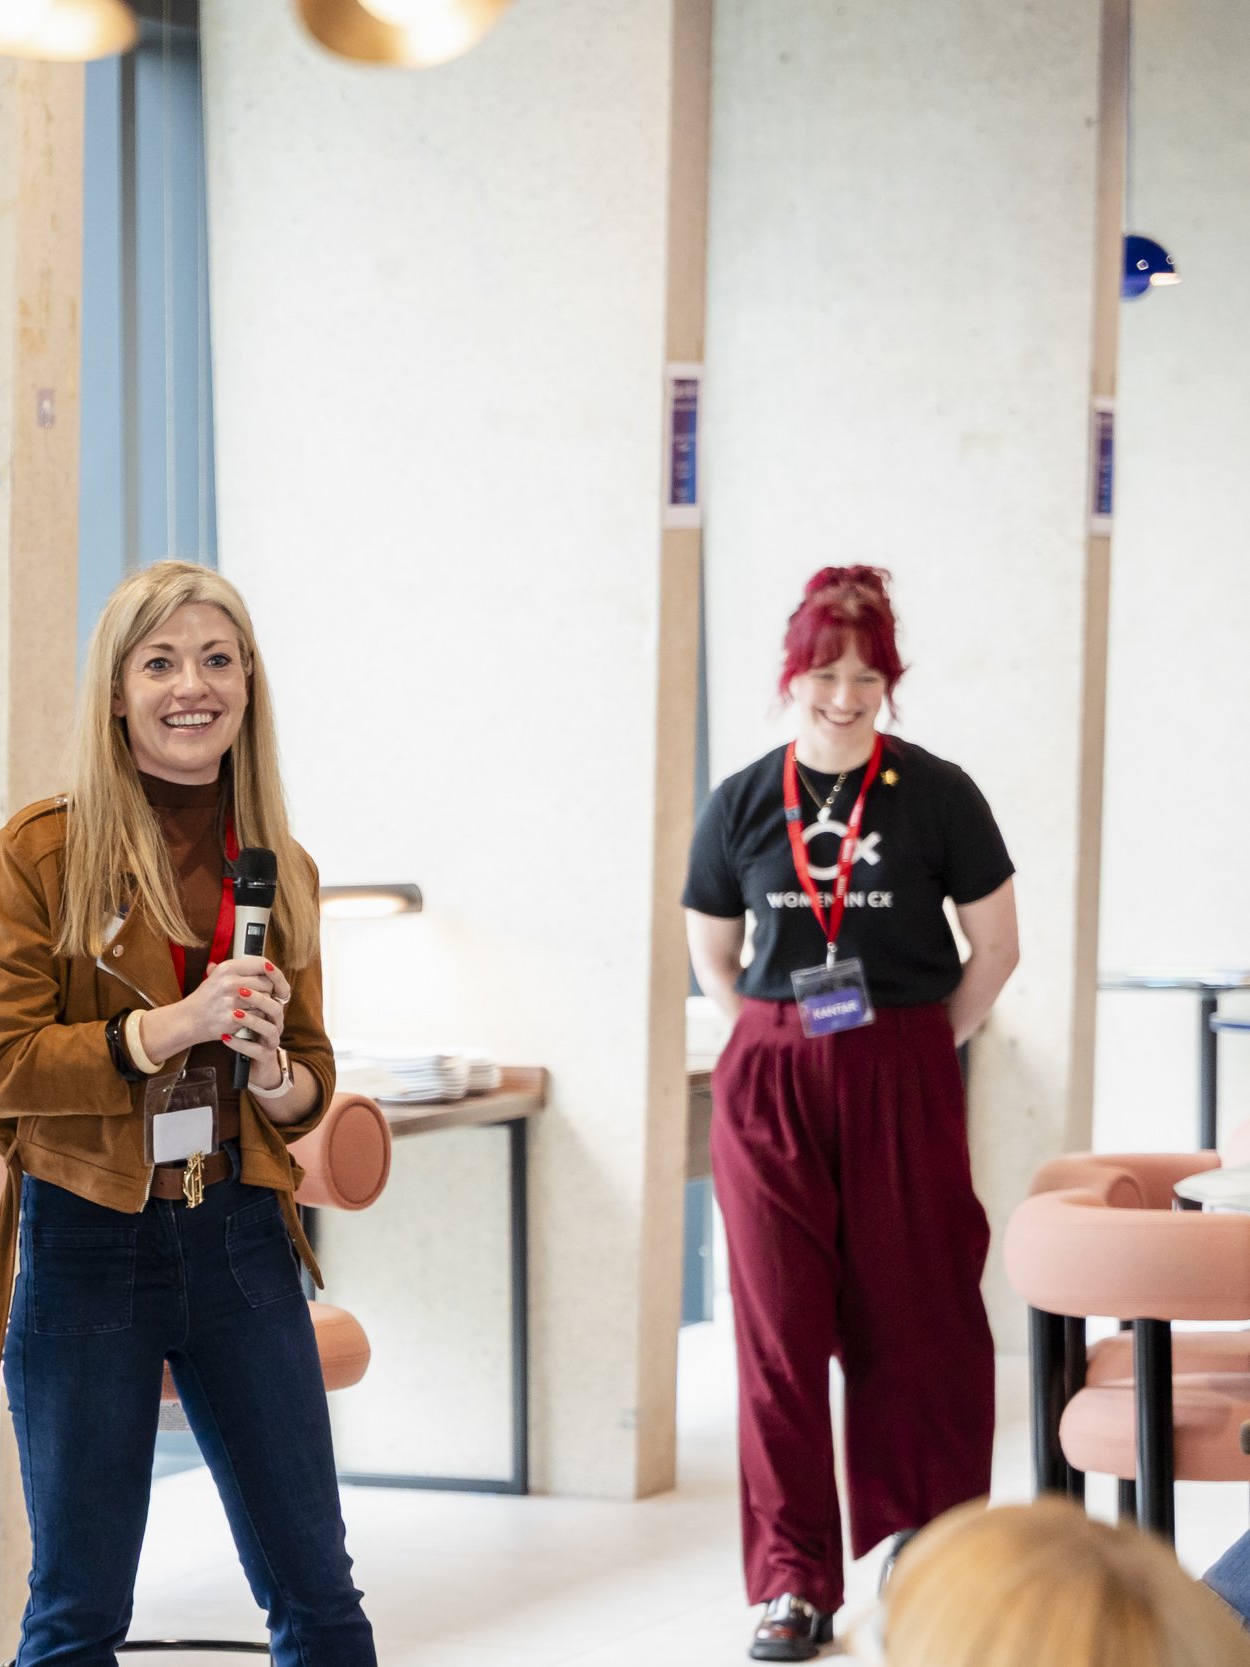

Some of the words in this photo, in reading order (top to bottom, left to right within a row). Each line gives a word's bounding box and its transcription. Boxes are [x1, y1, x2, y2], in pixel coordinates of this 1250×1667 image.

[844, 891, 865, 908] IN
[867, 891, 894, 908] CX
[811, 1000, 859, 1020] KANTAR
